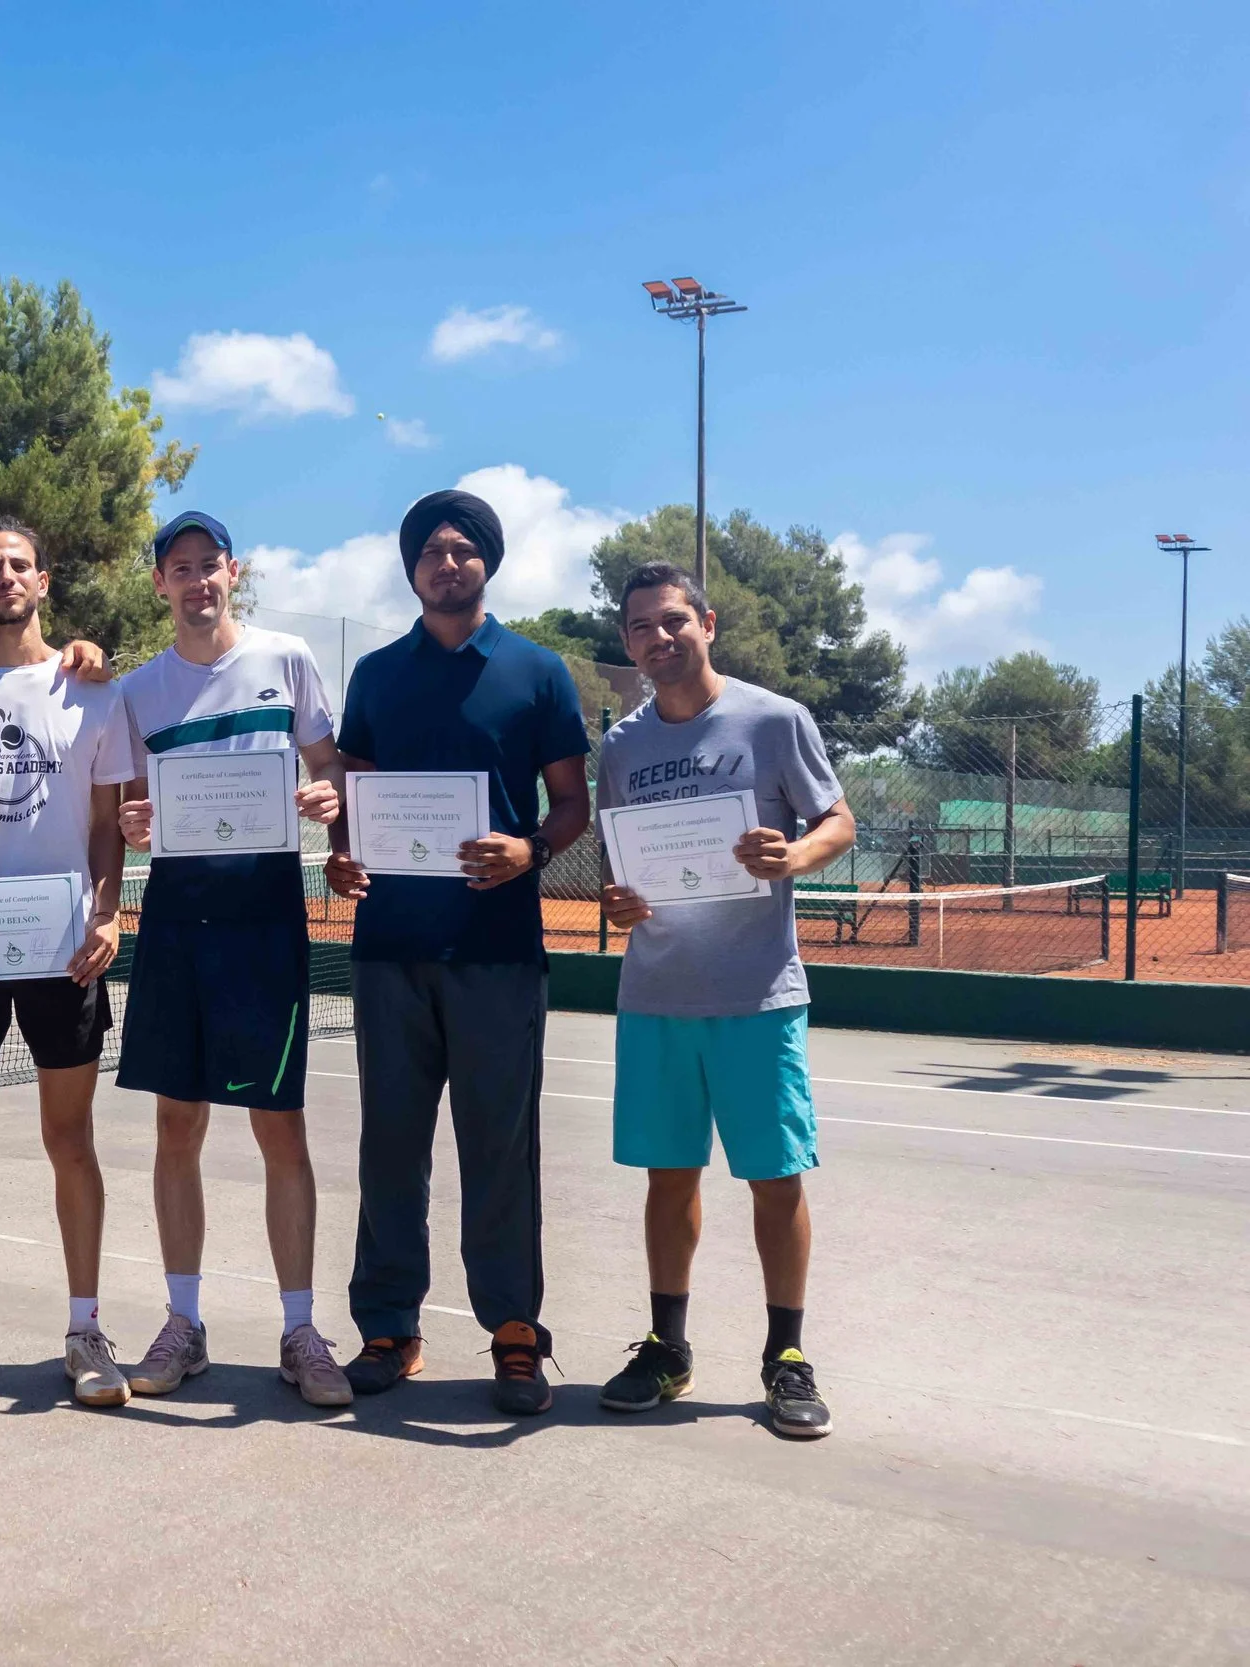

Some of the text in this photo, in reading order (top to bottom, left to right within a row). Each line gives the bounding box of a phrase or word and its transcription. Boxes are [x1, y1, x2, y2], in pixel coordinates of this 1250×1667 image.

[5, 760, 63, 775] ACADEMY
[181, 771, 215, 780] Certificate
[224, 769, 262, 779] Completion
[175, 792, 214, 801] NICOLAS
[378, 791, 410, 799] Certificate
[418, 792, 455, 800] Completion
[403, 812, 429, 821] SINGH
[665, 840, 694, 851] FELIPE
[697, 836, 725, 847] PIRES
[12, 894, 50, 903] Completion
[6, 915, 41, 925] BELSON
